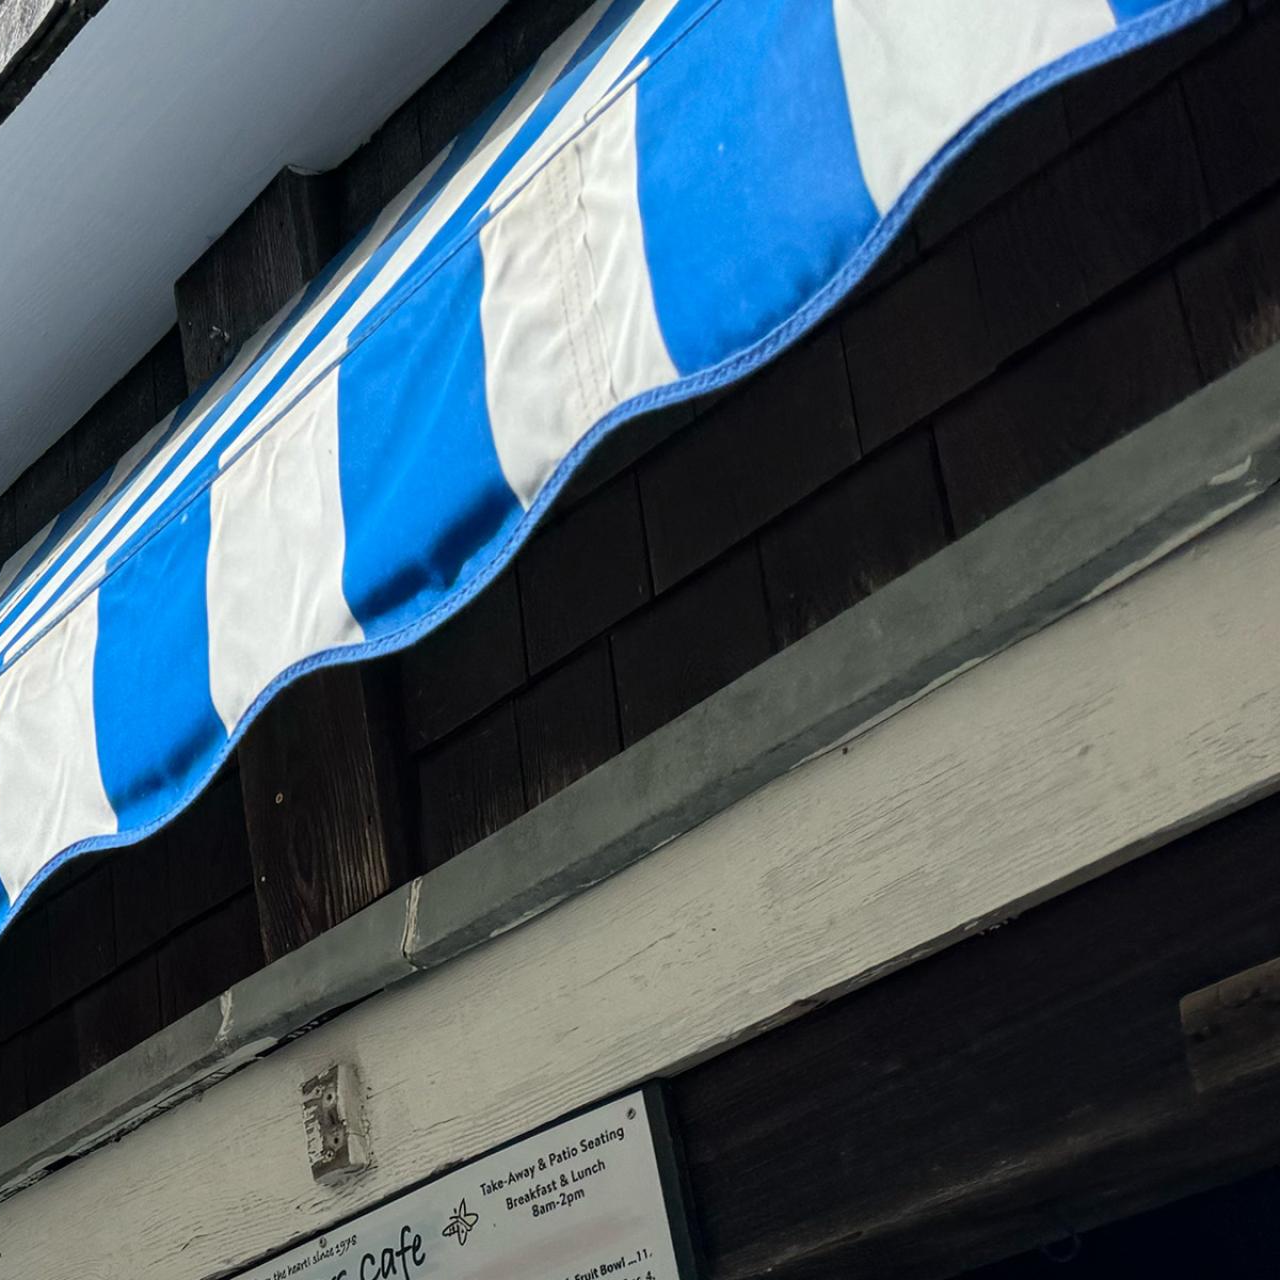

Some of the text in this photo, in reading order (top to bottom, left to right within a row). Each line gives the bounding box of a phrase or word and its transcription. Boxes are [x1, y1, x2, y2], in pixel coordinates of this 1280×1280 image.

[479, 1164, 536, 1196] Take-Away
[548, 1146, 579, 1167] Patio
[579, 1127, 625, 1153] Seating
[505, 1159, 606, 1211] Breakfast & Lunch
[531, 1188, 585, 1218] 8am-2pm
[599, 1256, 626, 1277] Bowl
[635, 1248, 653, 1264] 11.
[645, 1270, 656, 1280] 4.
